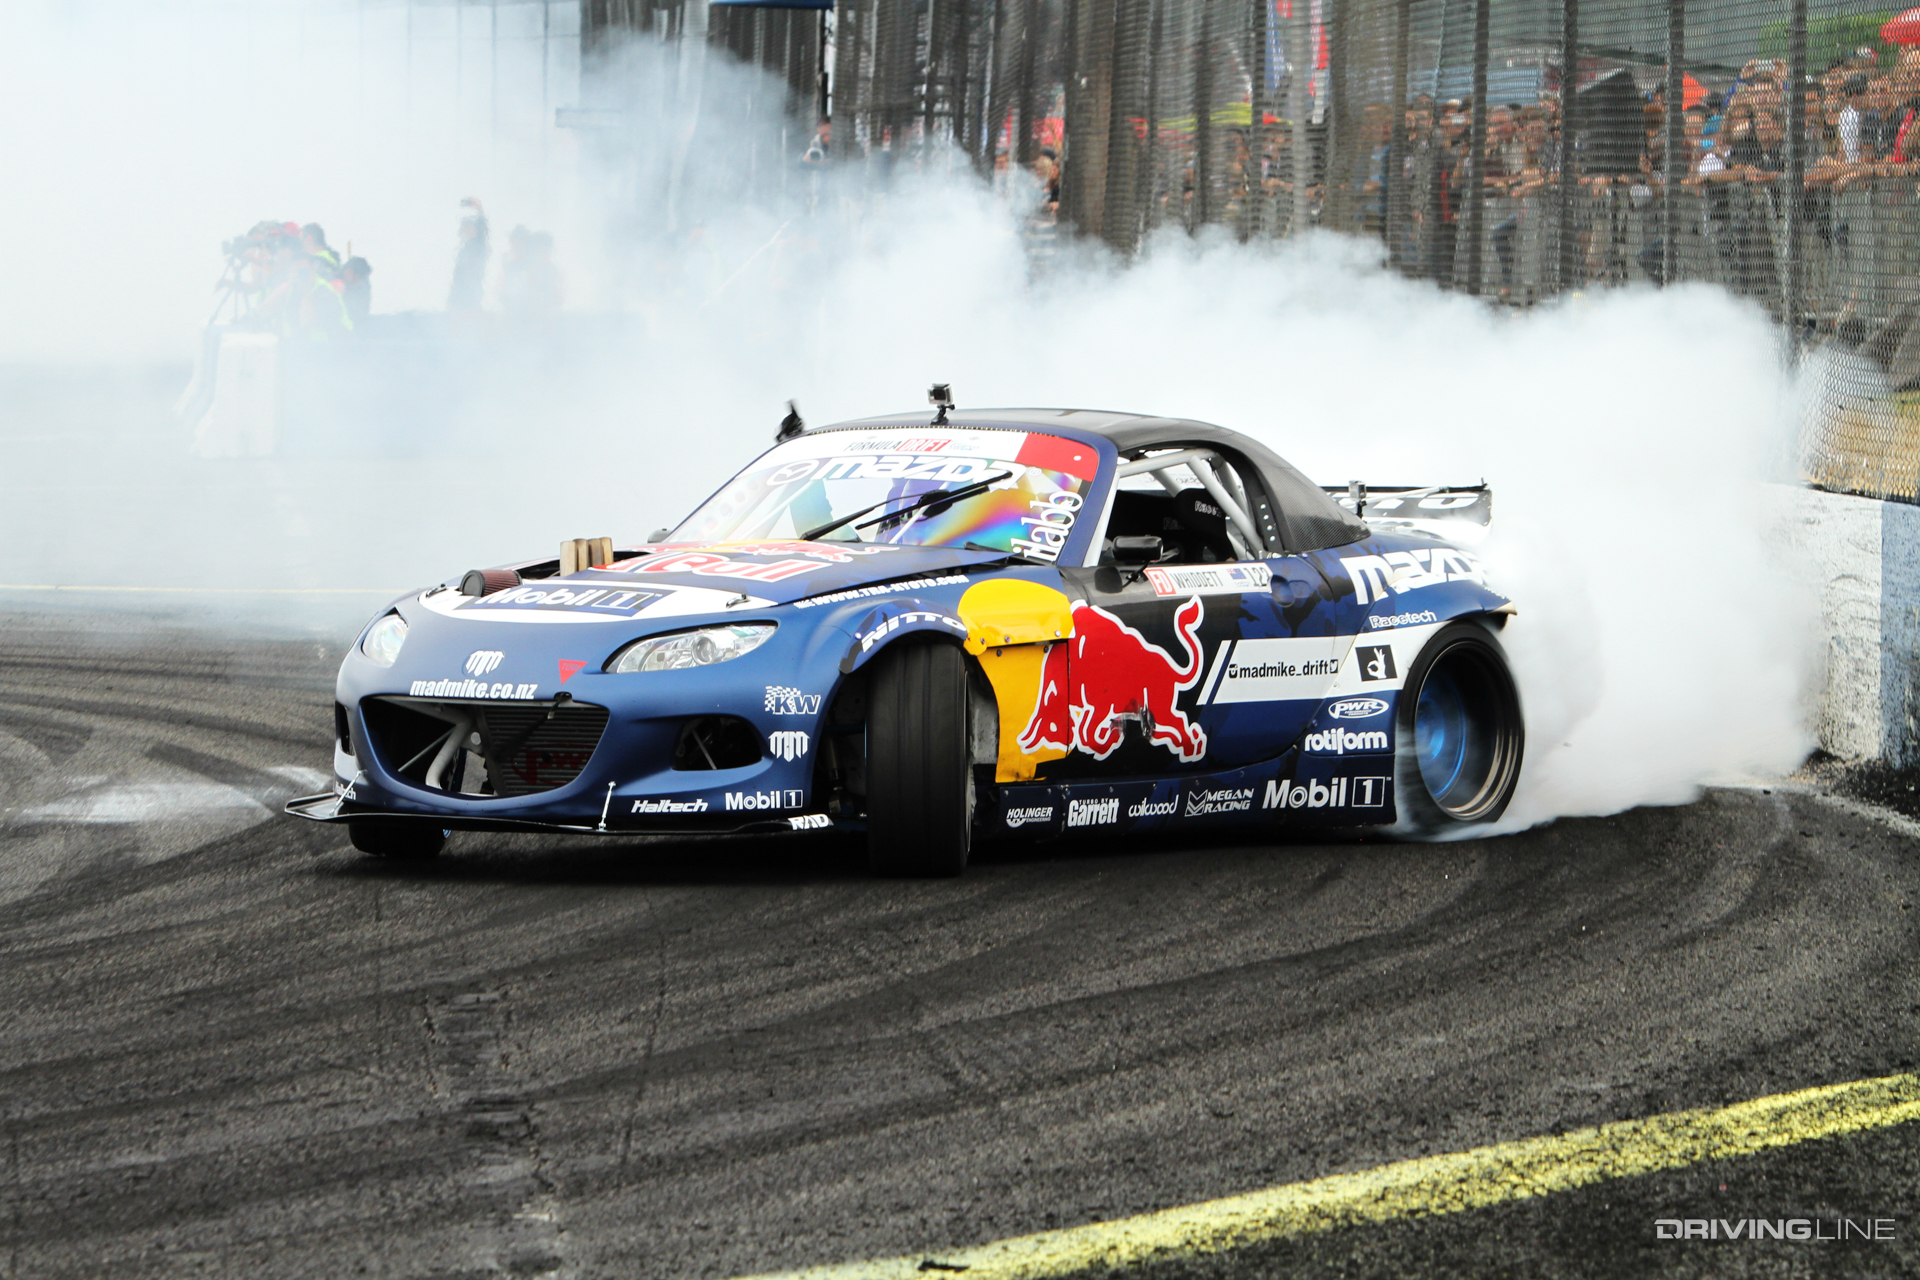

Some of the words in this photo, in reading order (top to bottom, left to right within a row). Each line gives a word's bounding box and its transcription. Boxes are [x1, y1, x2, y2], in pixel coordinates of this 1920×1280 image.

[843, 441, 902, 451] FORMULA
[899, 438, 952, 451] DRIFT
[1169, 571, 1223, 589] WHIDDETT
[1243, 566, 1271, 587] 122
[474, 587, 602, 606] Mobil
[1369, 609, 1438, 629] Racetech
[561, 662, 580, 672] TOW
[1239, 660, 1328, 679] madmike_drift
[409, 678, 538, 700] madmike.co.nz
[773, 694, 821, 715] KW
[1334, 701, 1388, 719] PWR
[1304, 727, 1388, 755] rotiform
[630, 799, 709, 813] Haltech
[725, 790, 781, 811] Mobil
[1206, 788, 1254, 802] MEGAN
[1262, 776, 1348, 810] Mobil
[1006, 806, 1054, 819] HOLINGER
[1067, 797, 1120, 828] Garrett
[1203, 800, 1251, 814] RACING
